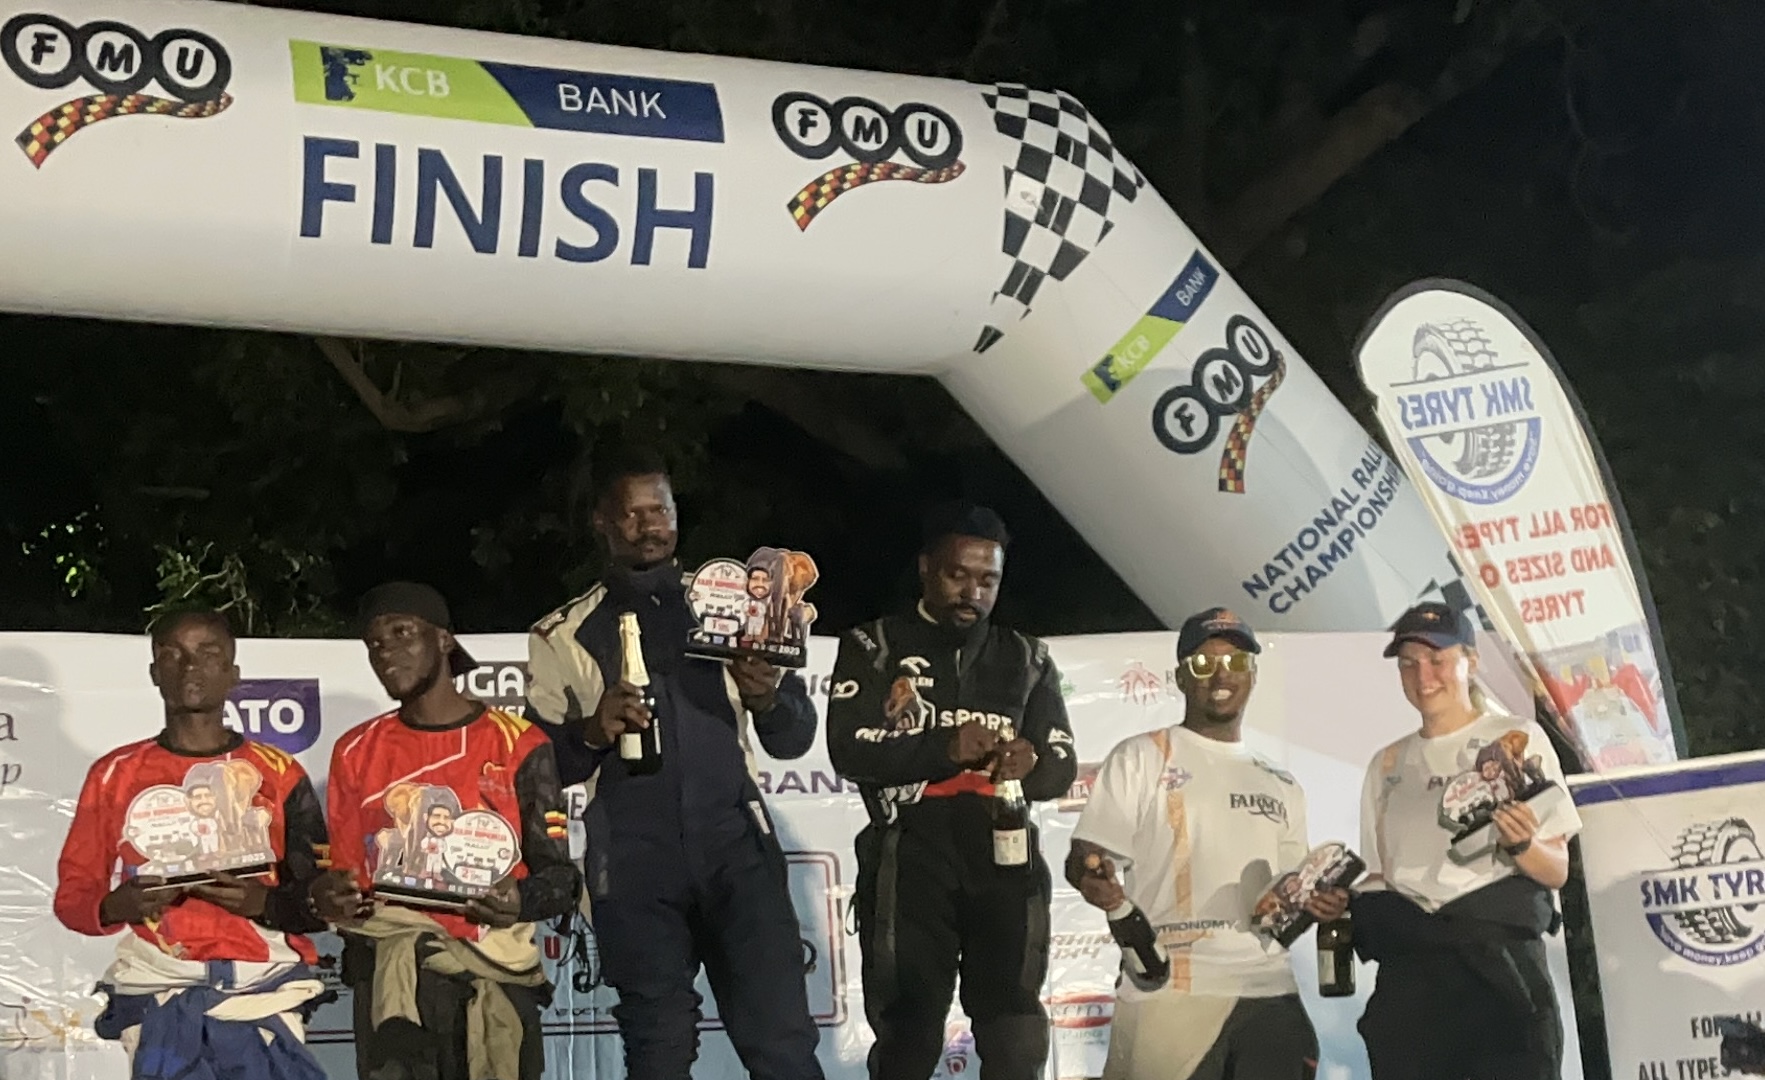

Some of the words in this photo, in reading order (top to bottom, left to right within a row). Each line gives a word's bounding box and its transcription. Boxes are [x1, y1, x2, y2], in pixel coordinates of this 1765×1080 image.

[374, 64, 451, 98] KCB
[557, 82, 669, 121] BANK
[299, 135, 715, 269] FINISH
[1115, 332, 1152, 375] KCB
[1175, 265, 1207, 307] BANK
[1241, 486, 1361, 599] NATIONAL
[1350, 438, 1383, 491] RALL
[222, 698, 305, 734] ATO
[1641, 875, 1700, 908] SMK
